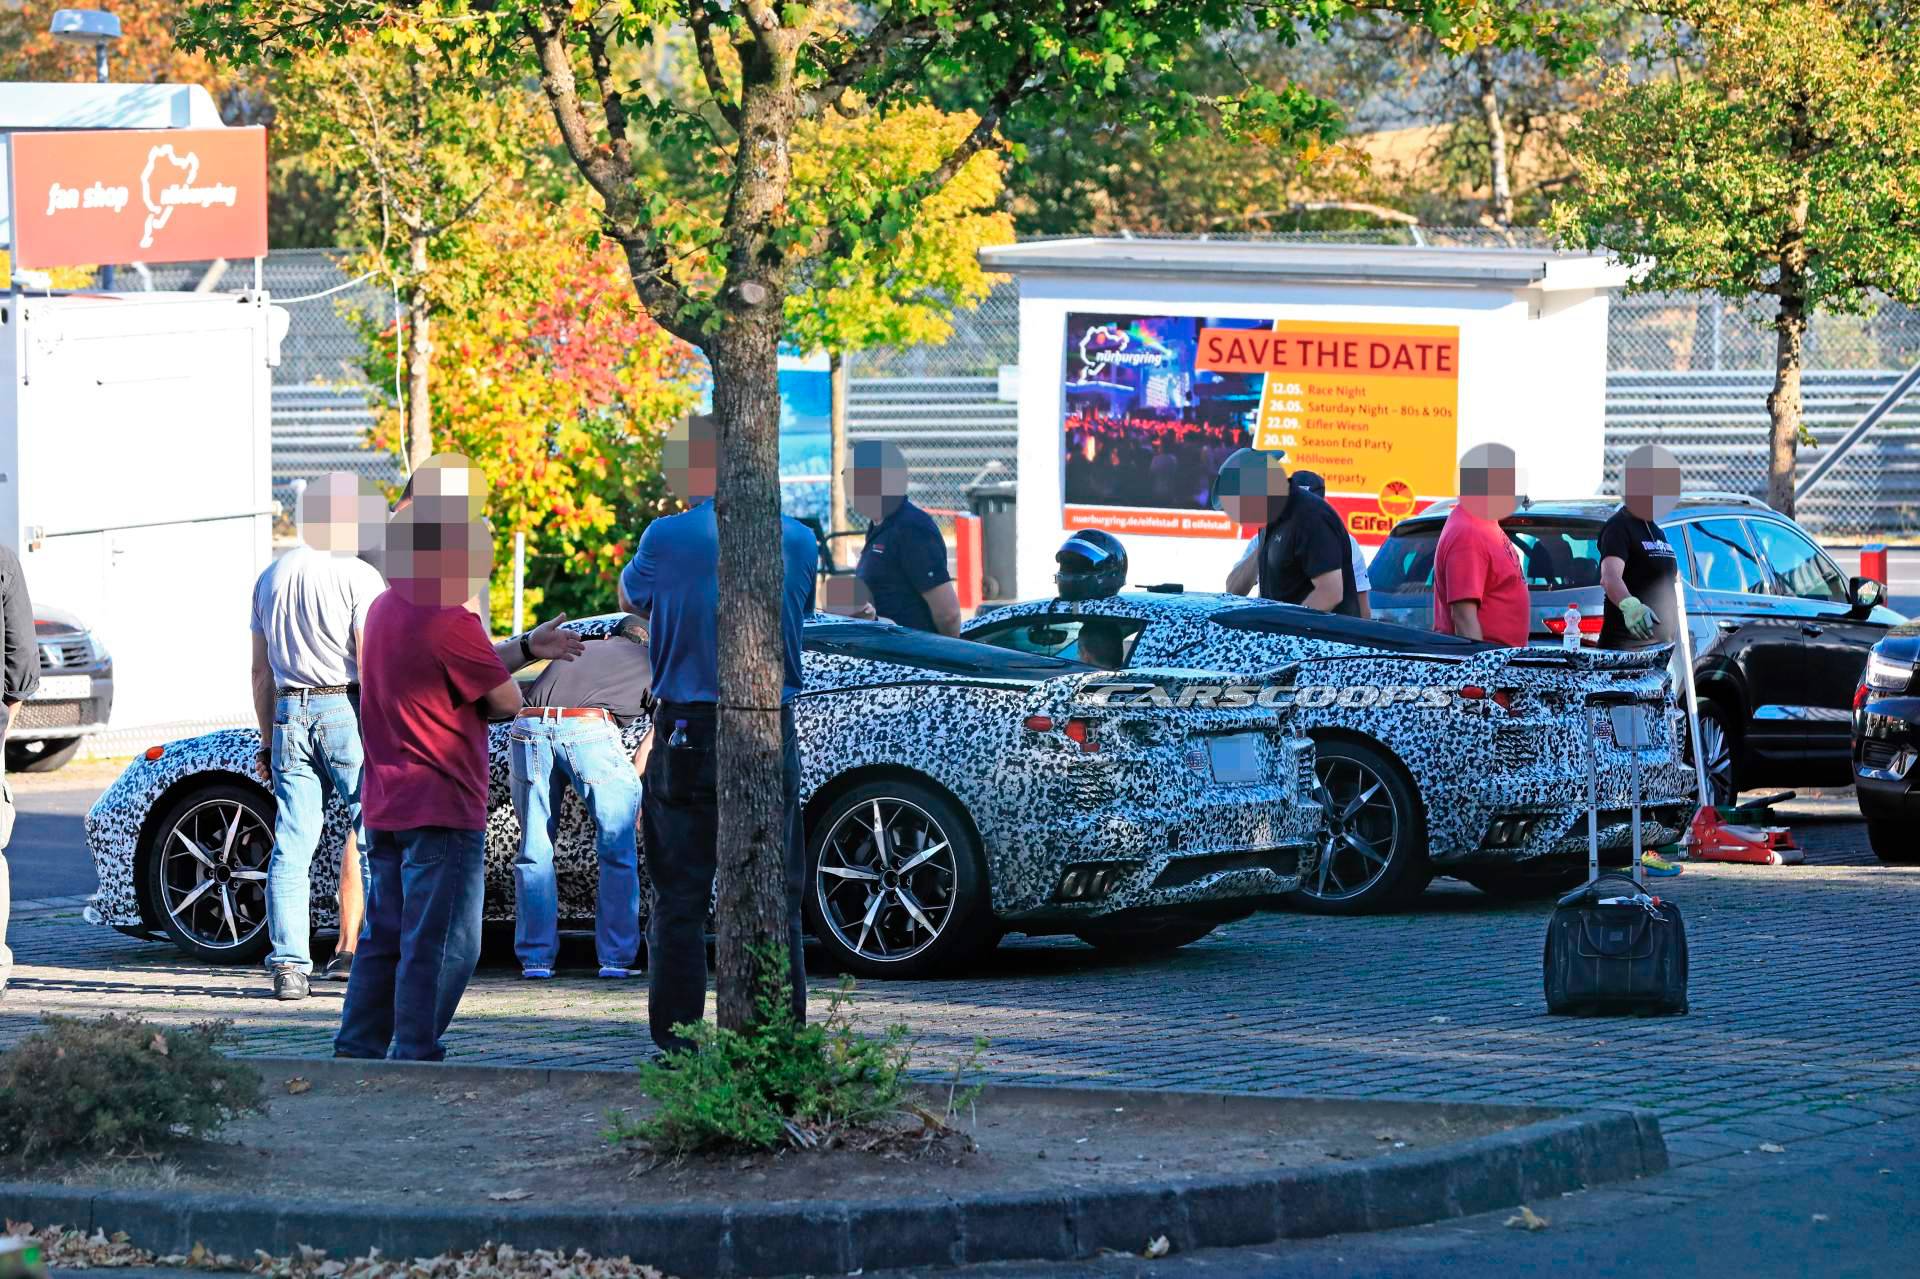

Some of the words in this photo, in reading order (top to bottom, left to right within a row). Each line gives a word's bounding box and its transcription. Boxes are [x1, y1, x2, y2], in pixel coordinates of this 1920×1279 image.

[47, 183, 79, 215] fan
[83, 181, 128, 212] shop
[1095, 351, 1162, 366] nürburgring
[1208, 337, 1287, 366] SAVE
[1296, 340, 1358, 368] THE
[1370, 343, 1452, 371] DATE
[1272, 383, 1303, 395] 12.05.
[1308, 384, 1333, 395] Race
[1337, 385, 1366, 399] Night
[1308, 402, 1355, 416] Saturday
[1359, 404, 1388, 417] Night
[1400, 406, 1419, 416] 80s
[1422, 406, 1430, 416] &
[1433, 406, 1452, 417] 90s
[1267, 416, 1301, 429] 22.09.
[1306, 419, 1333, 430] Eifler
[1337, 420, 1369, 431] Wiesn
[1264, 433, 1297, 446] 20.10.
[1302, 436, 1339, 447] Season
[1342, 437, 1361, 449] End
[1364, 438, 1393, 452] Party
[1322, 472, 1367, 486] terparty
[1350, 515, 1394, 531] Eifel
